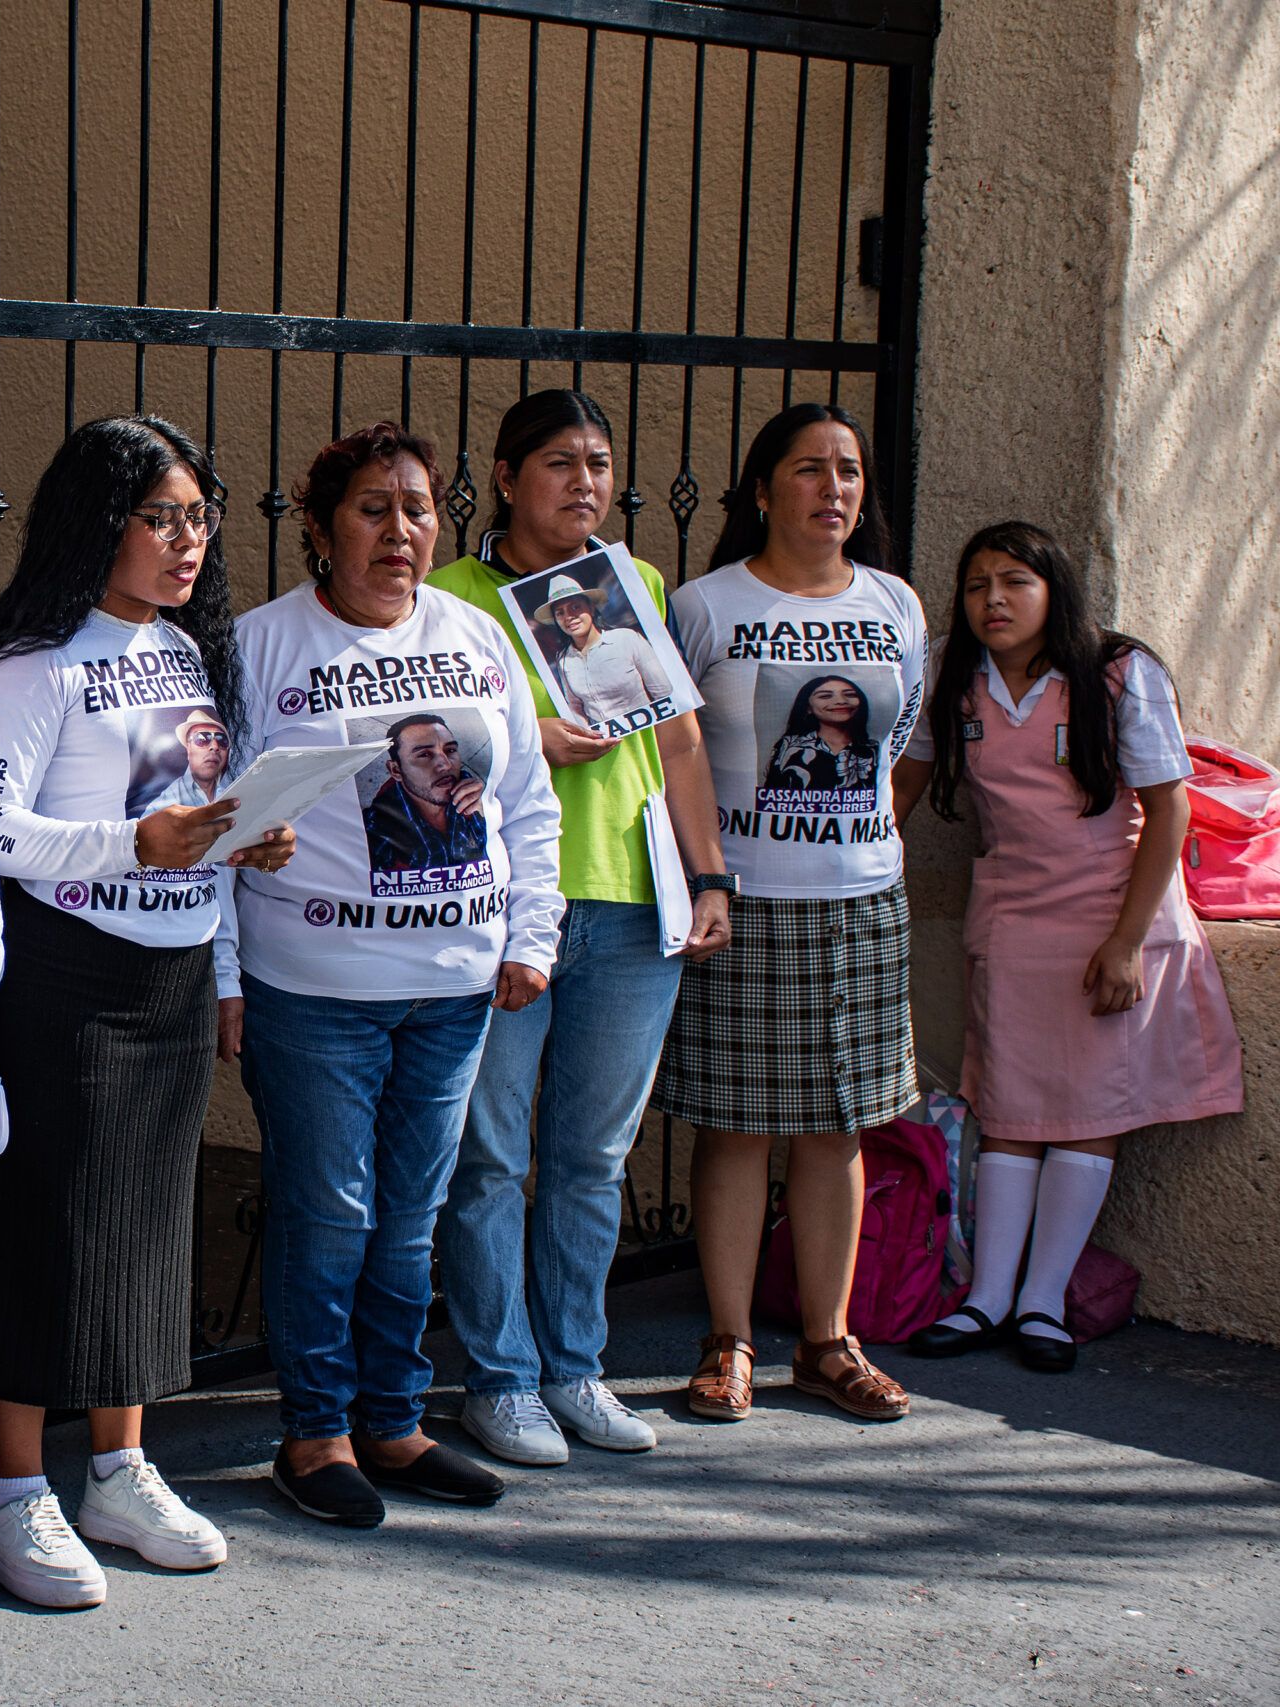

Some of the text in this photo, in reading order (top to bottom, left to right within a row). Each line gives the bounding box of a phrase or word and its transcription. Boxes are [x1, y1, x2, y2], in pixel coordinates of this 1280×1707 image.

[734, 621, 898, 644] MADRES
[728, 642, 762, 660] EN
[82, 649, 202, 685] MADRES
[310, 651, 472, 690] MADRES
[84, 685, 121, 714] EN
[307, 689, 342, 715] EN
[350, 673, 493, 709] RESISTENCIA
[757, 788, 875, 803] CASSANDRA ISABEL
[763, 802, 872, 813] ARIAS TORRES
[729, 808, 761, 838] NI
[770, 813, 843, 845] UNA
[850, 811, 888, 843] MÁS
[373, 859, 491, 886] NECTAR
[91, 882, 128, 911] NI
[138, 885, 202, 912] UNO
[376, 881, 443, 897] GALDAMEZ
[337, 901, 375, 929] NI
[385, 901, 463, 929] UNO
[468, 885, 505, 926] MÁS
